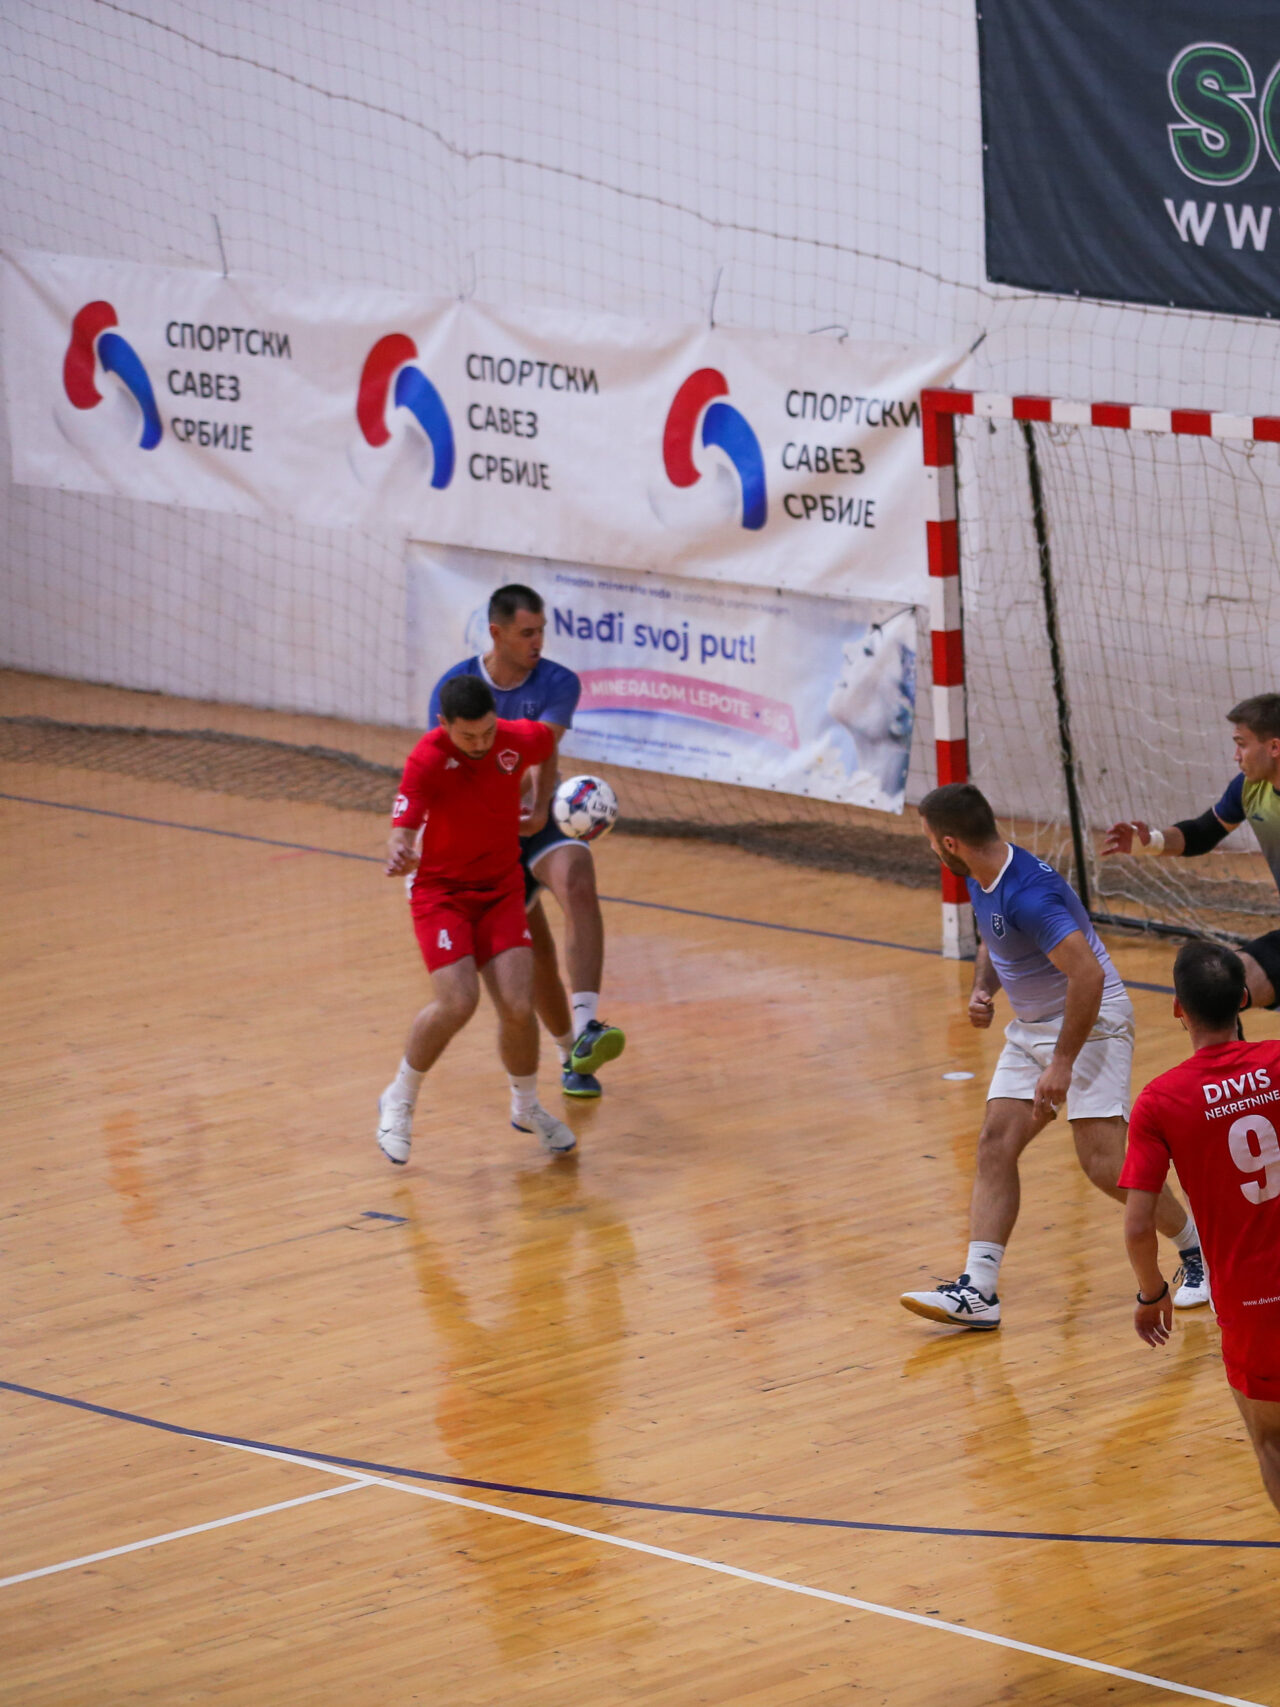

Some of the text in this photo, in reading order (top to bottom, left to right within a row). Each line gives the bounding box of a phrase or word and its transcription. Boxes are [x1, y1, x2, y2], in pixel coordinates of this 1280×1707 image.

[166, 321, 292, 359] СПОРТСКИ
[168, 369, 240, 402] САВЕЗ
[466, 353, 599, 394] СПОРТСКИ
[468, 403, 538, 438] САВЕЗ
[785, 390, 921, 428] СПОРТСКИ
[171, 417, 253, 451] СРБИЈЕ
[469, 453, 551, 490] СРБИЈЕ
[782, 442, 865, 474] САВЕЗ
[783, 494, 875, 528] СРБИЈЕ
[553, 607, 756, 664] Nađi svoj put!
[591, 678, 686, 701] MINERALOM
[690, 687, 750, 719] LEPOTE
[437, 929, 453, 950] 4
[1202, 1068, 1271, 1104] DIVIS
[1204, 1089, 1280, 1120] NEKRETNINE
